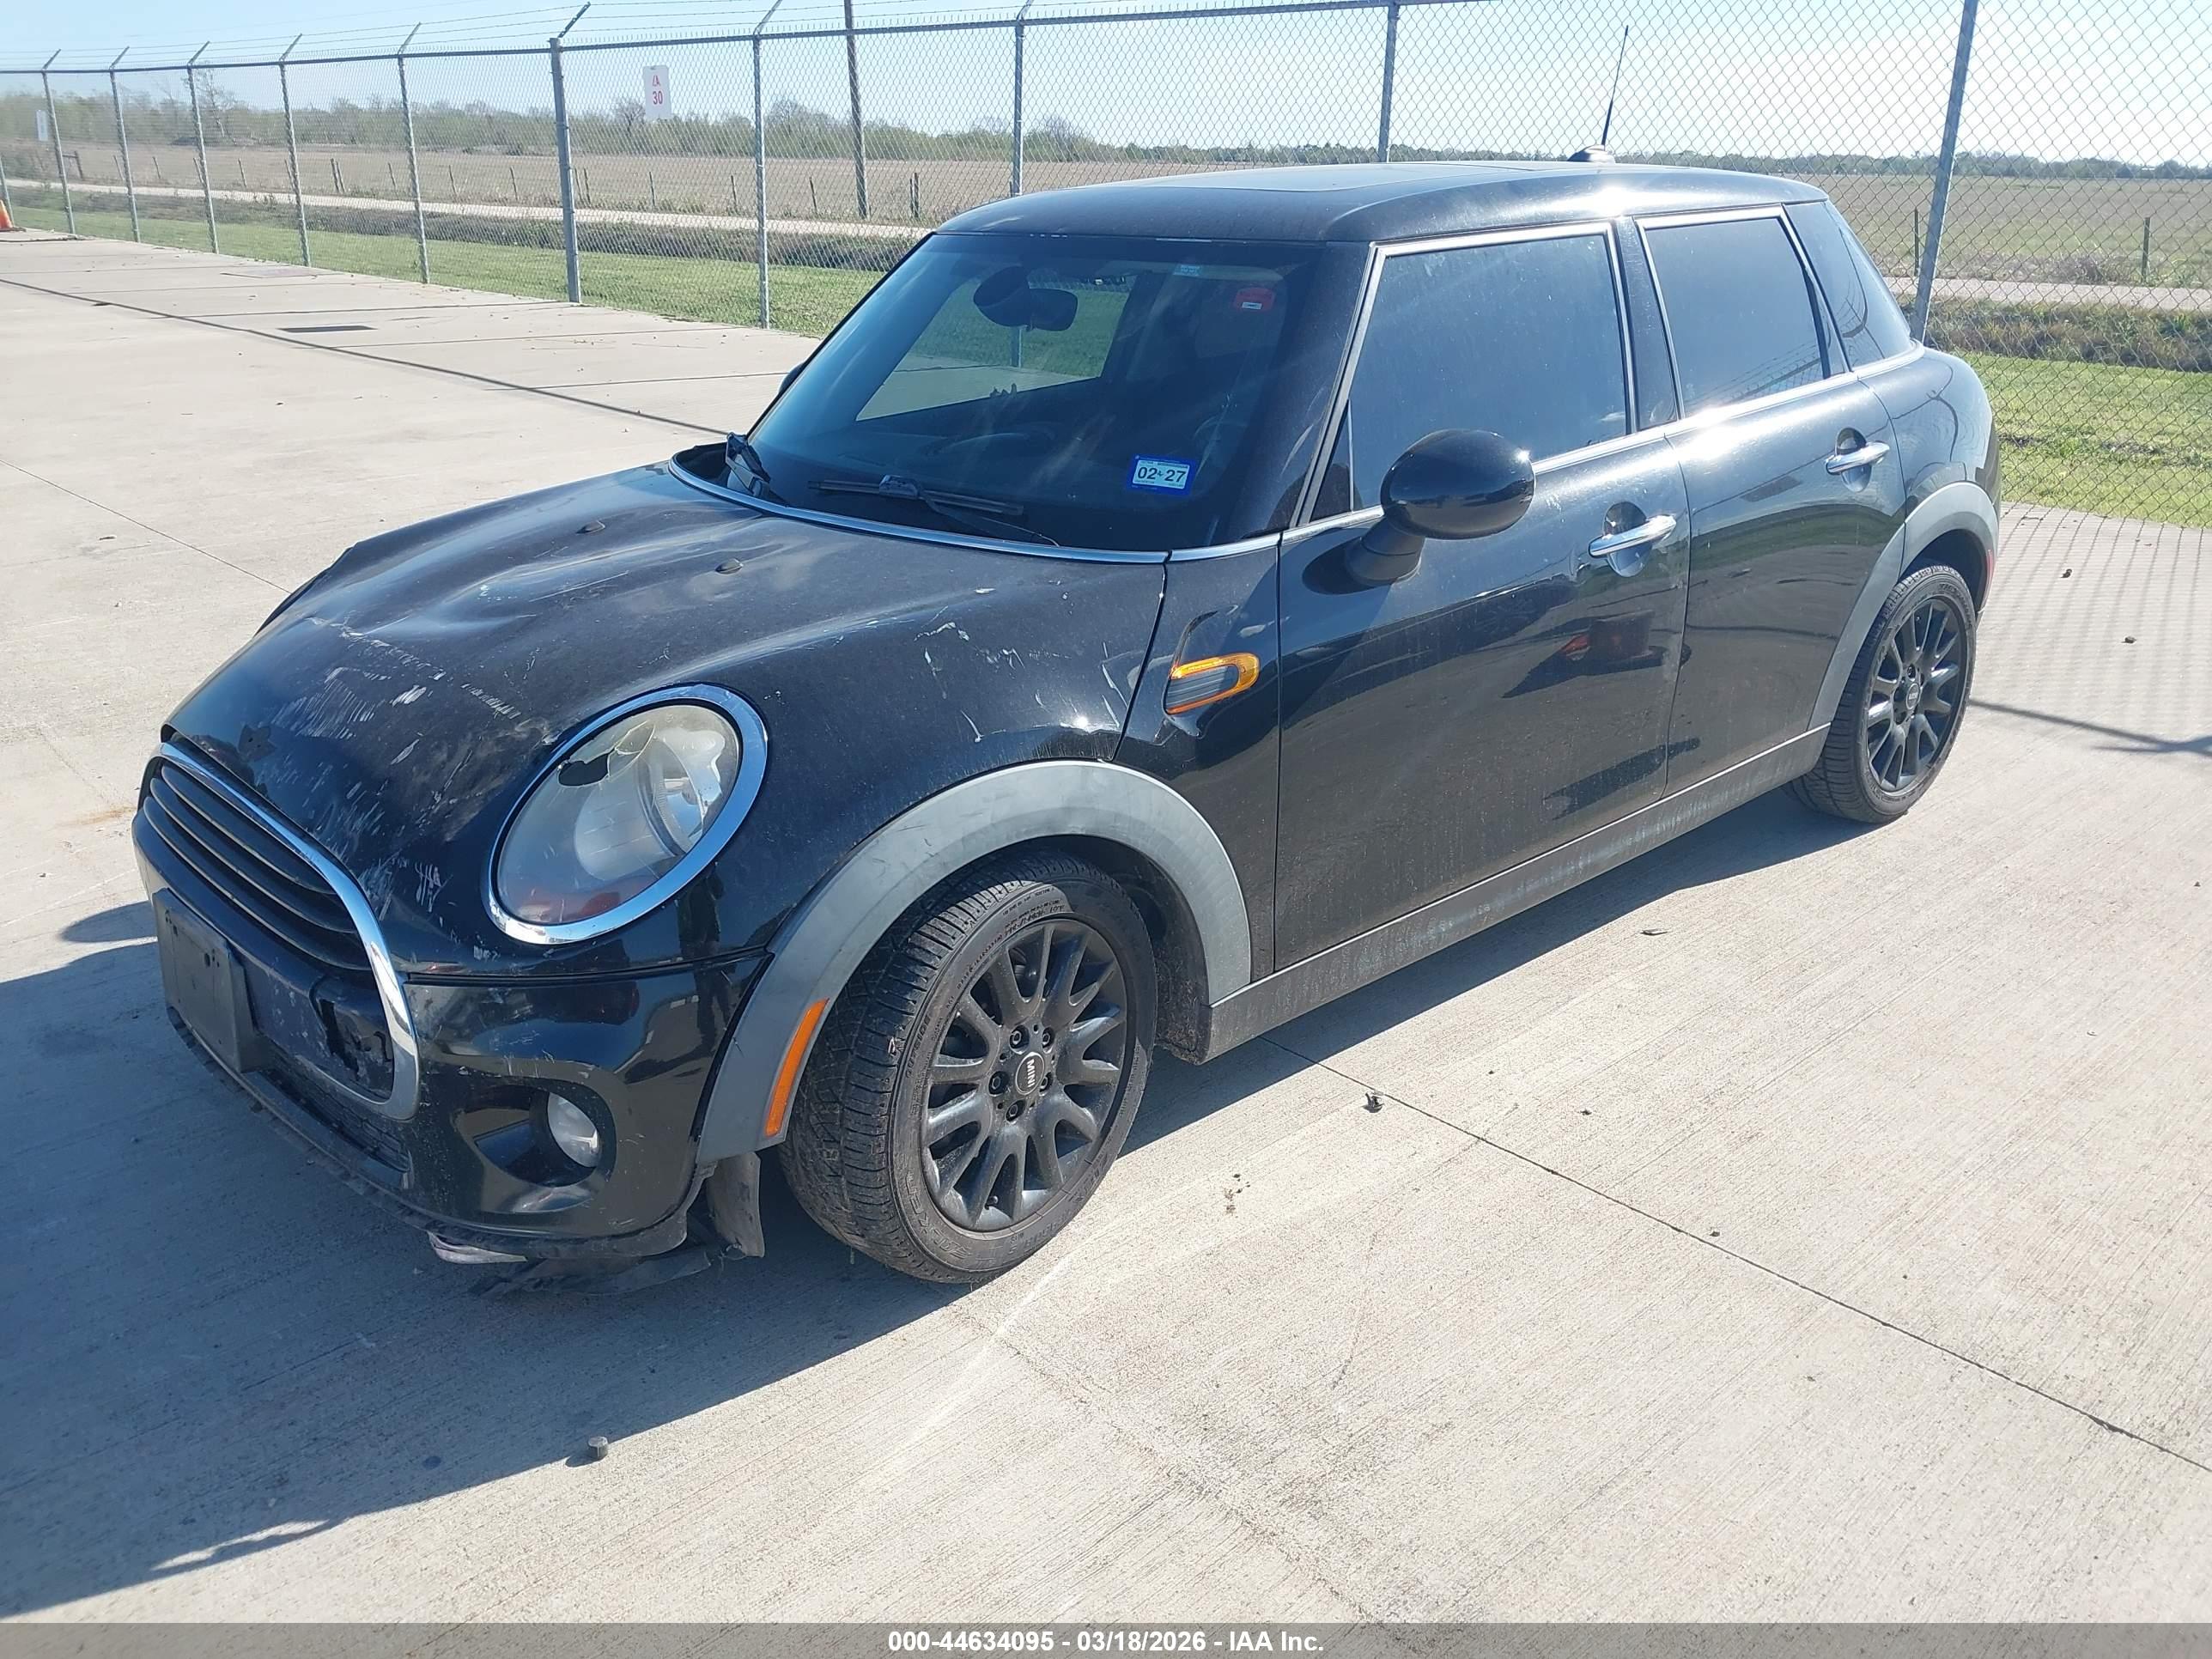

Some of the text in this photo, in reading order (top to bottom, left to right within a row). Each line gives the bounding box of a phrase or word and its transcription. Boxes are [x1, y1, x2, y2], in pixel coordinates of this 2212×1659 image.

[653, 90, 664, 105] 30
[1138, 466, 1187, 483] 02 27
[1026, 1058, 1036, 1088] MINI
